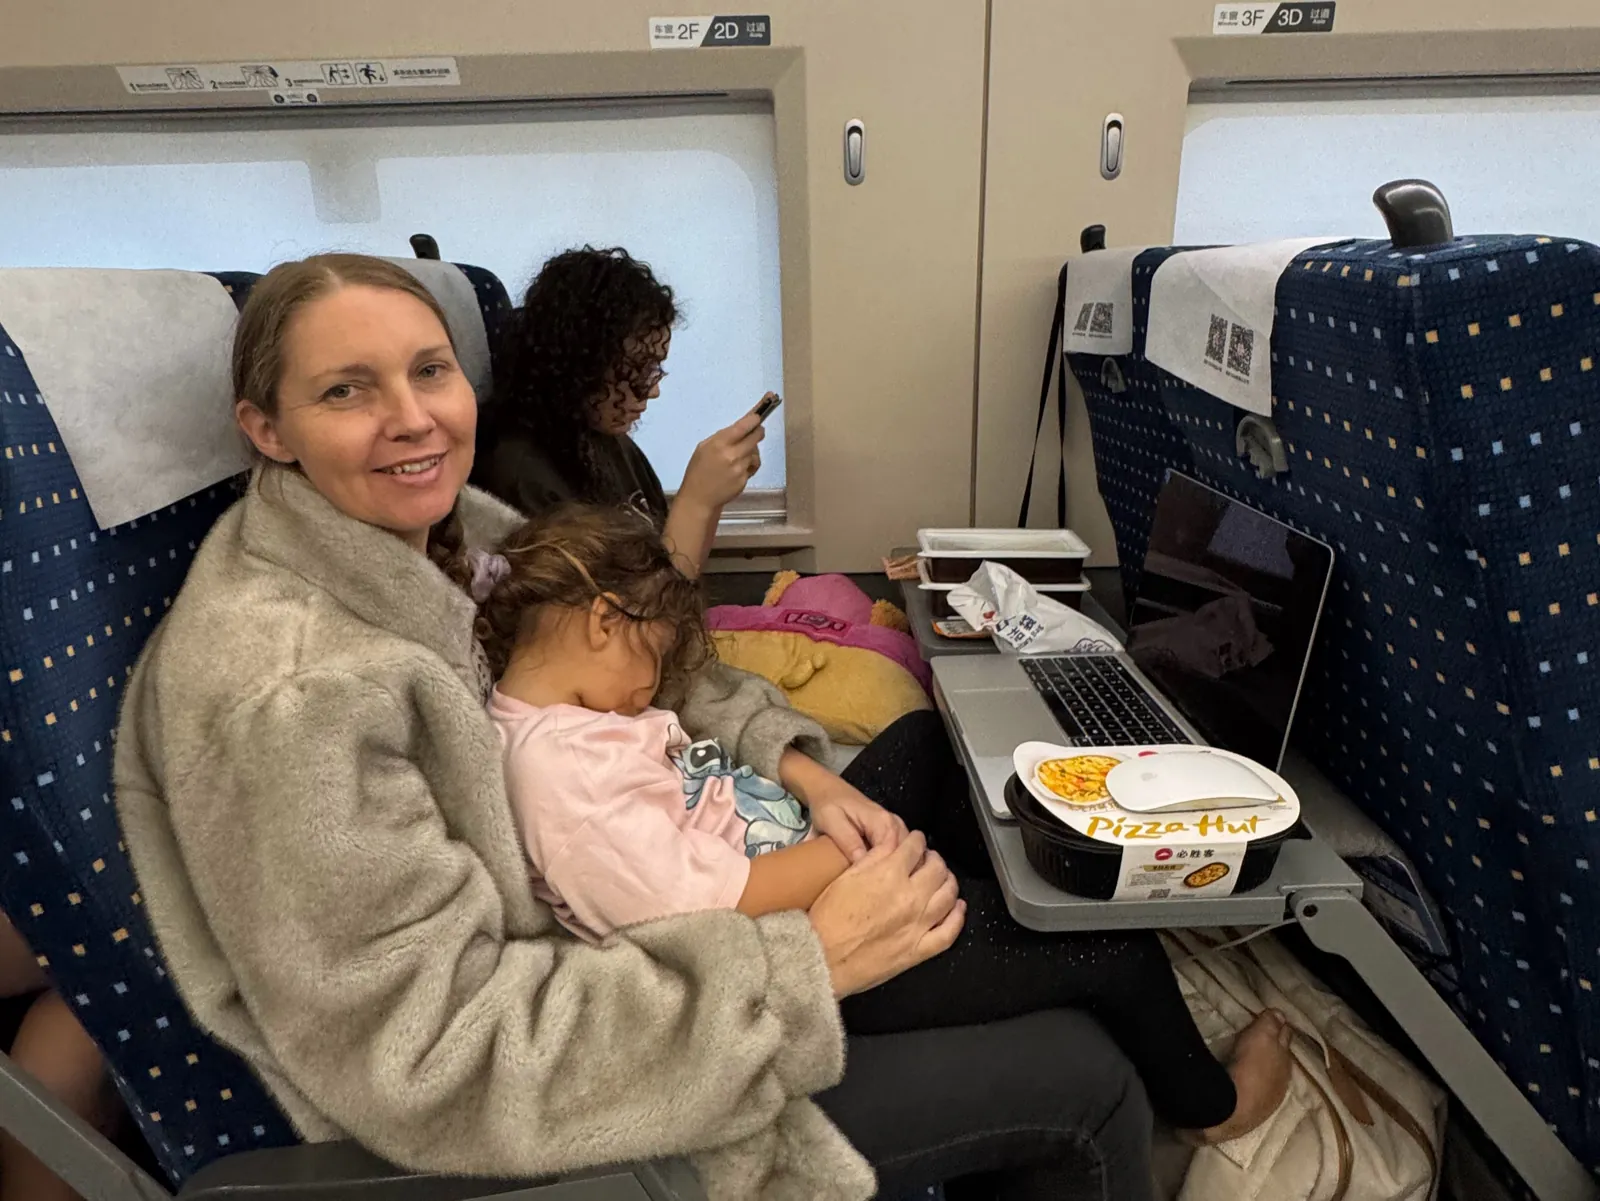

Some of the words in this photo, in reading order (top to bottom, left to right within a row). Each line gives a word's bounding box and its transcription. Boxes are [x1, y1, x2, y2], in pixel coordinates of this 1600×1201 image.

[1241, 9, 1265, 27] 3F
[1277, 8, 1303, 26] 3D
[677, 23, 700, 40] 2F
[714, 22, 739, 39] 2D
[209, 79, 219, 90] 2
[285, 78, 293, 88] 3
[1087, 815, 1190, 840] Pizza
[1192, 814, 1271, 837] Hut
[1176, 848, 1215, 859] 必胜客
